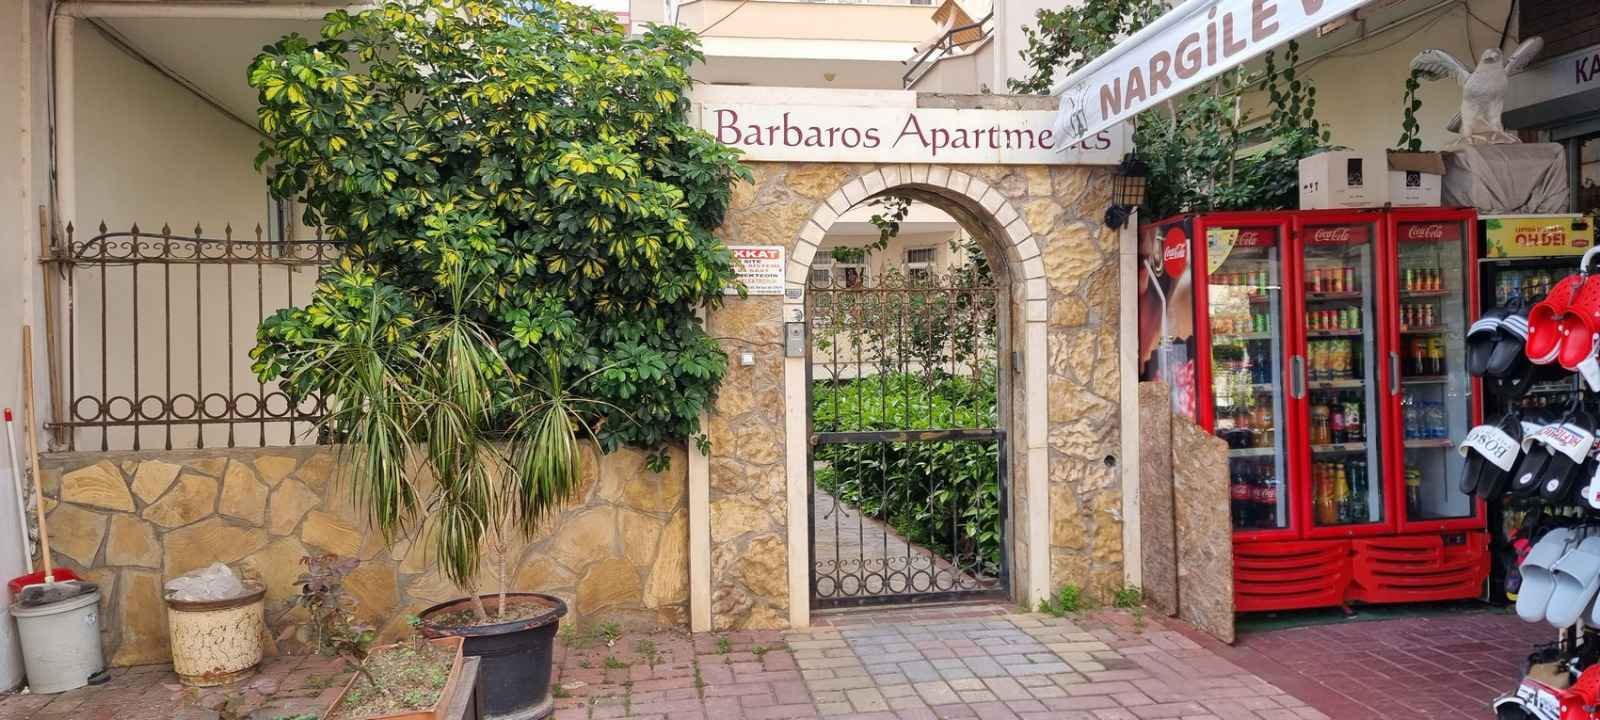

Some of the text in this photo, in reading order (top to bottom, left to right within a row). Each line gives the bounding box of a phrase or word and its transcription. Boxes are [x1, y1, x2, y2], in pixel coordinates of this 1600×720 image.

[1099, 0, 1280, 121] NARGİLE
[713, 108, 1112, 157] Barbaros Apartmes
[733, 249, 778, 259] KKAT
